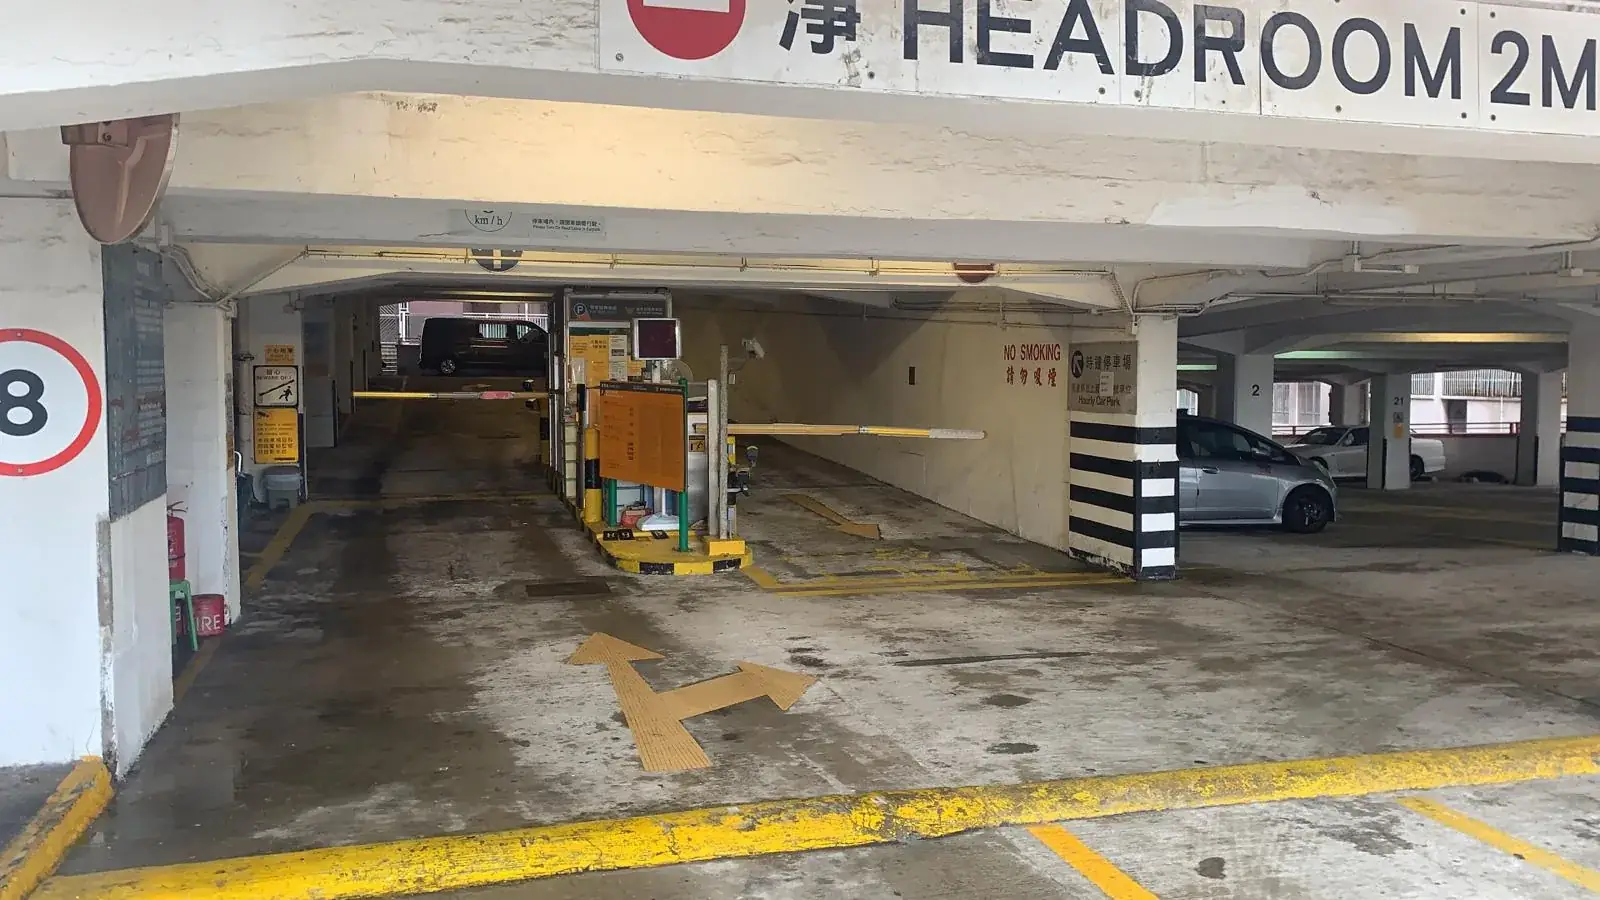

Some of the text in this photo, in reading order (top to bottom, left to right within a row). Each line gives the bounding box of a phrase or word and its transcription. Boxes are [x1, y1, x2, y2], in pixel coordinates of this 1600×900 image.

[903, 0, 1597, 111] HEADROOM 2M
[1003, 343, 1061, 361] NO SMOKING
[1006, 366, 1057, 387] 請勿吸煙
[1251, 384, 1260, 397] 2
[0, 369, 48, 437] 8
[1078, 396, 1121, 407] Hourly Car Park
[1393, 396, 1404, 406] 21
[195, 614, 221, 632] IRE
